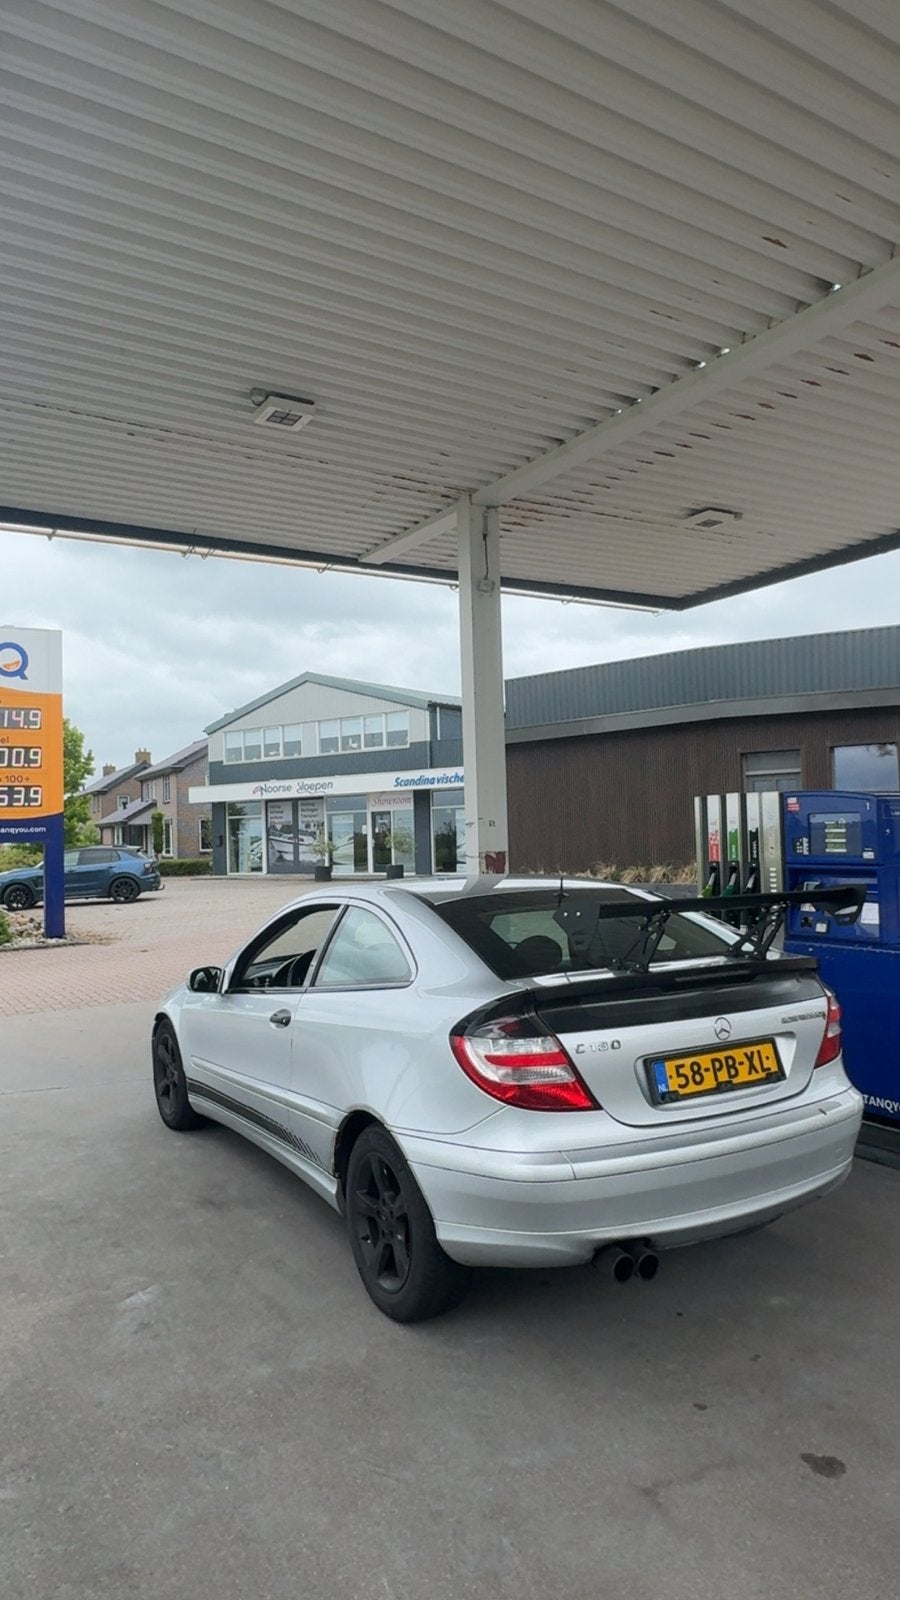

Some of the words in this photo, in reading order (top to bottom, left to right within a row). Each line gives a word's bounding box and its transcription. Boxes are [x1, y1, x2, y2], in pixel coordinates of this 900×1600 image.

[393, 772, 465, 788] Scandinavische
[260, 784, 292, 796] Noorse
[575, 1044, 586, 1054] C
[674, 1050, 771, 1089] 58-PB-XL
[863, 1094, 900, 1113] TANQY
